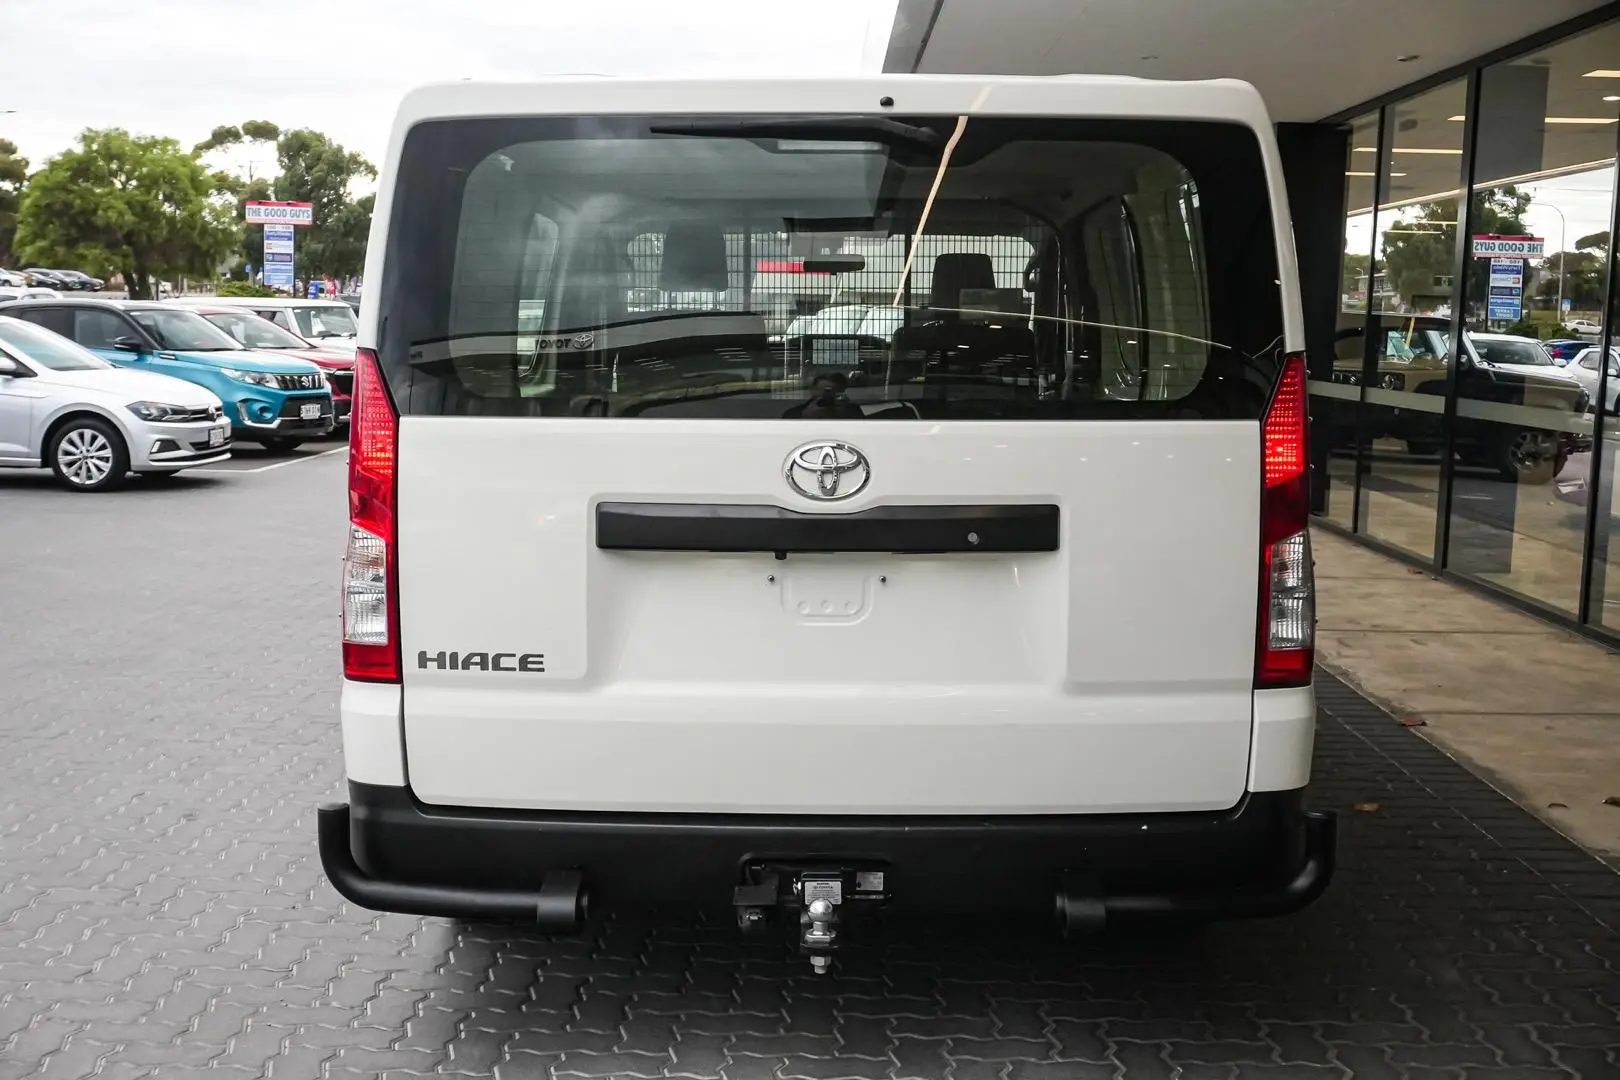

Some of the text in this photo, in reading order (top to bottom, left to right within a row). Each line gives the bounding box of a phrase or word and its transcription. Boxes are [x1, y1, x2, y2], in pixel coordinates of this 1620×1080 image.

[247, 207, 310, 219] THE GOOD GUYS
[417, 650, 545, 672] HIACE
